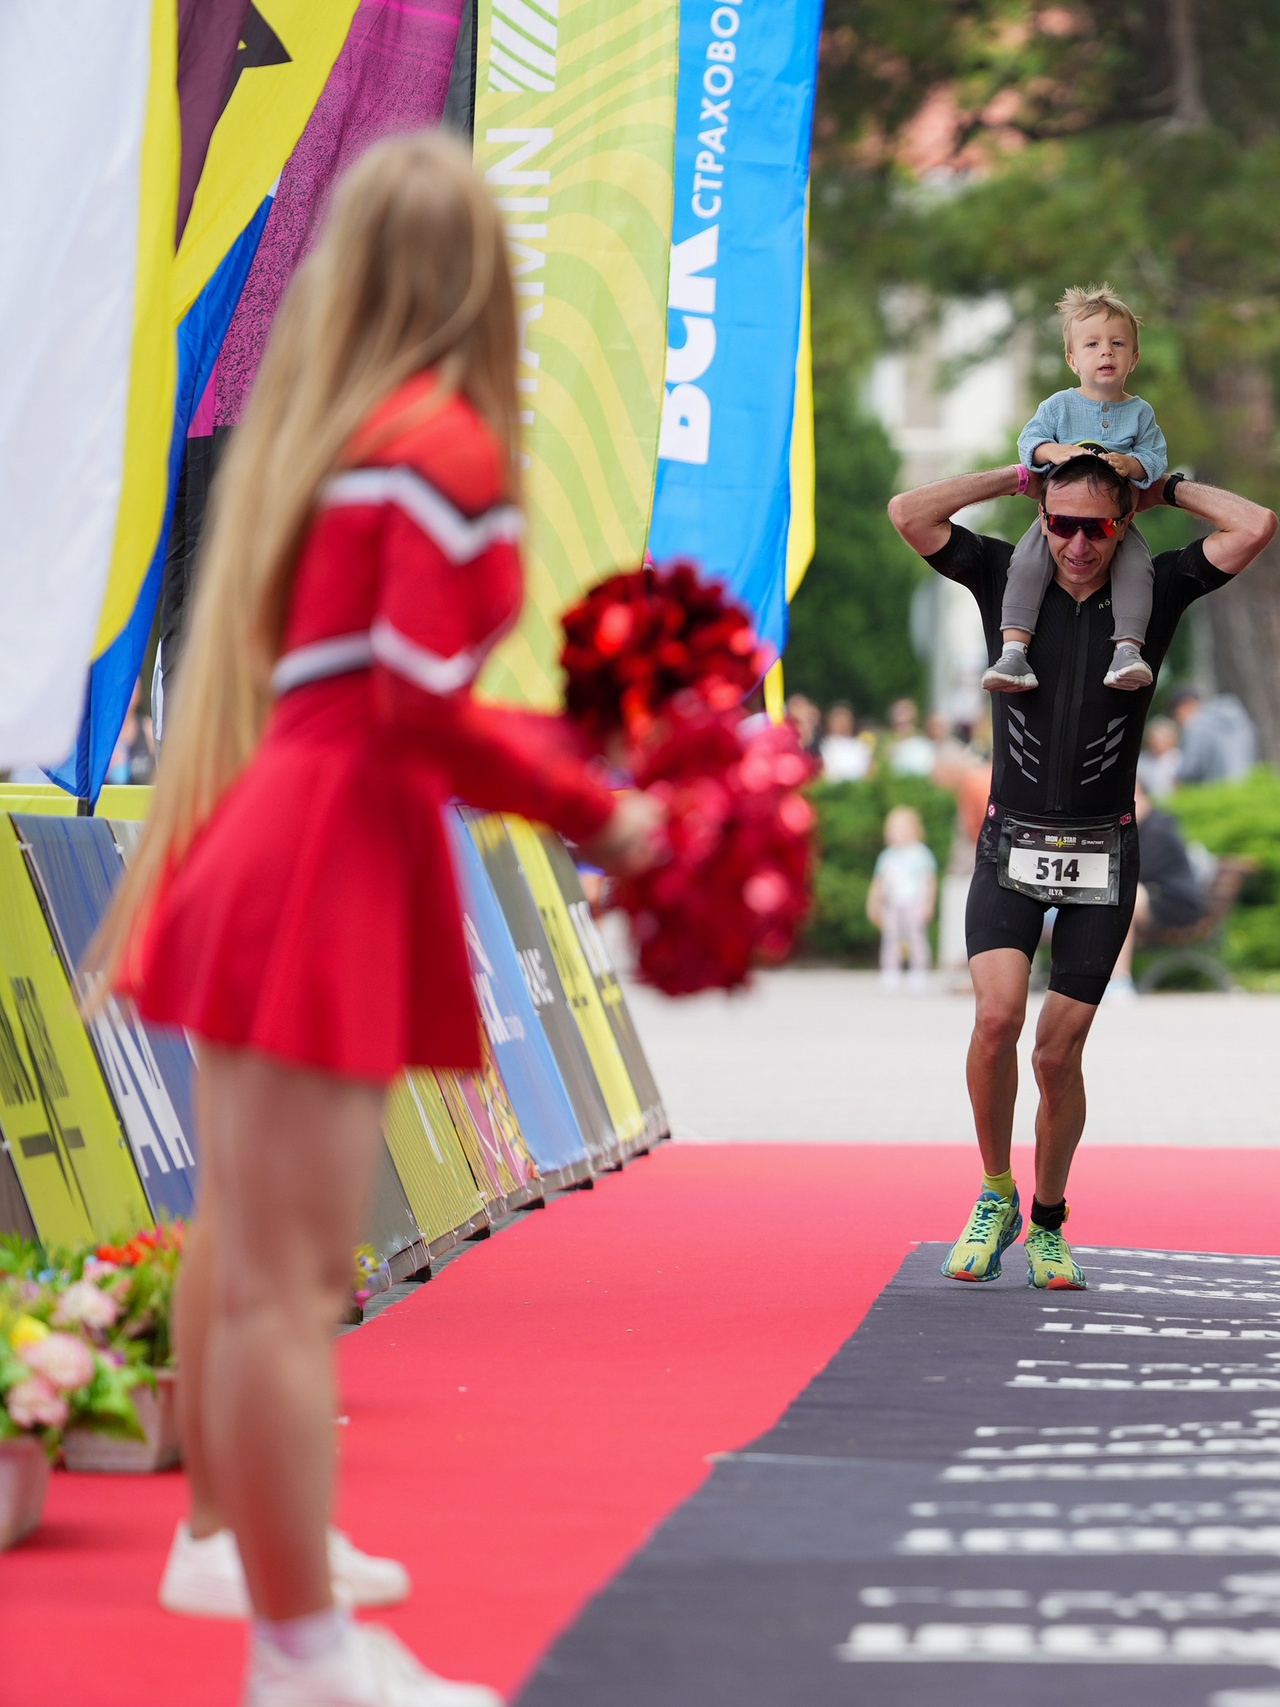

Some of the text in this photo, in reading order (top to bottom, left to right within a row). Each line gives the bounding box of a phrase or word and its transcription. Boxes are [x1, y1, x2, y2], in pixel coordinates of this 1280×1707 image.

[691, 0, 743, 219] СТРАХОВО
[1064, 836, 1077, 844] STAR
[1035, 856, 1080, 882] 514
[1048, 888, 1064, 897] ILYA
